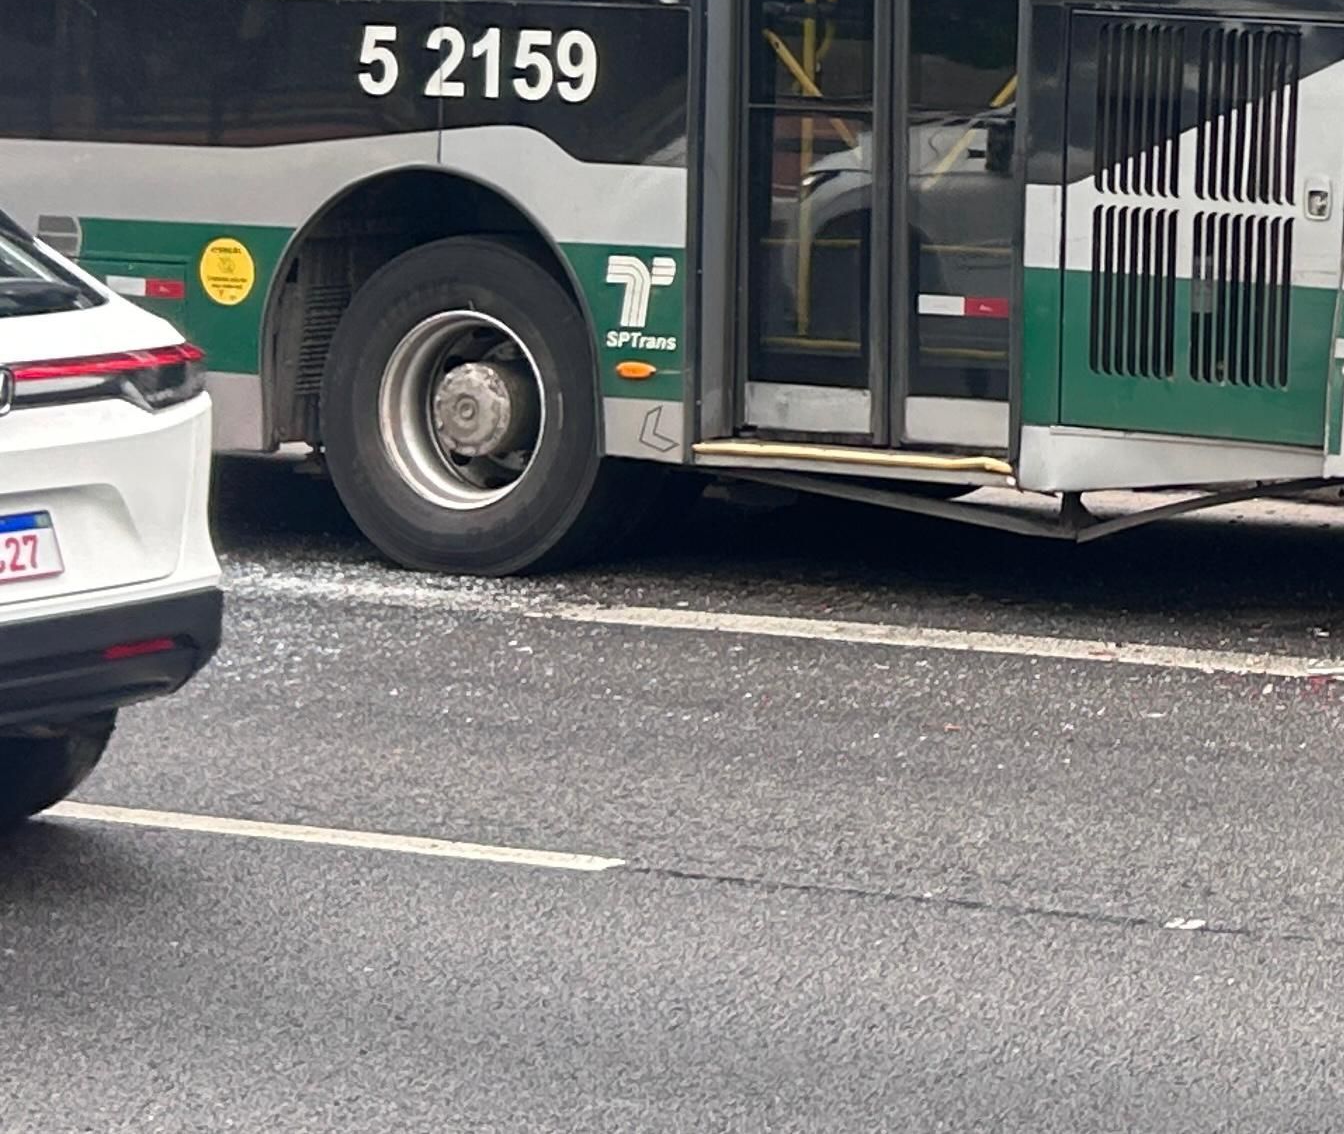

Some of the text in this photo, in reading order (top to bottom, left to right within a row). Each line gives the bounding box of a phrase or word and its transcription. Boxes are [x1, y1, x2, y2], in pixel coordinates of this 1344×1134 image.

[358, 24, 599, 103] 5 2159
[605, 329, 678, 352] SPTrans
[0, 534, 39, 574] 27
